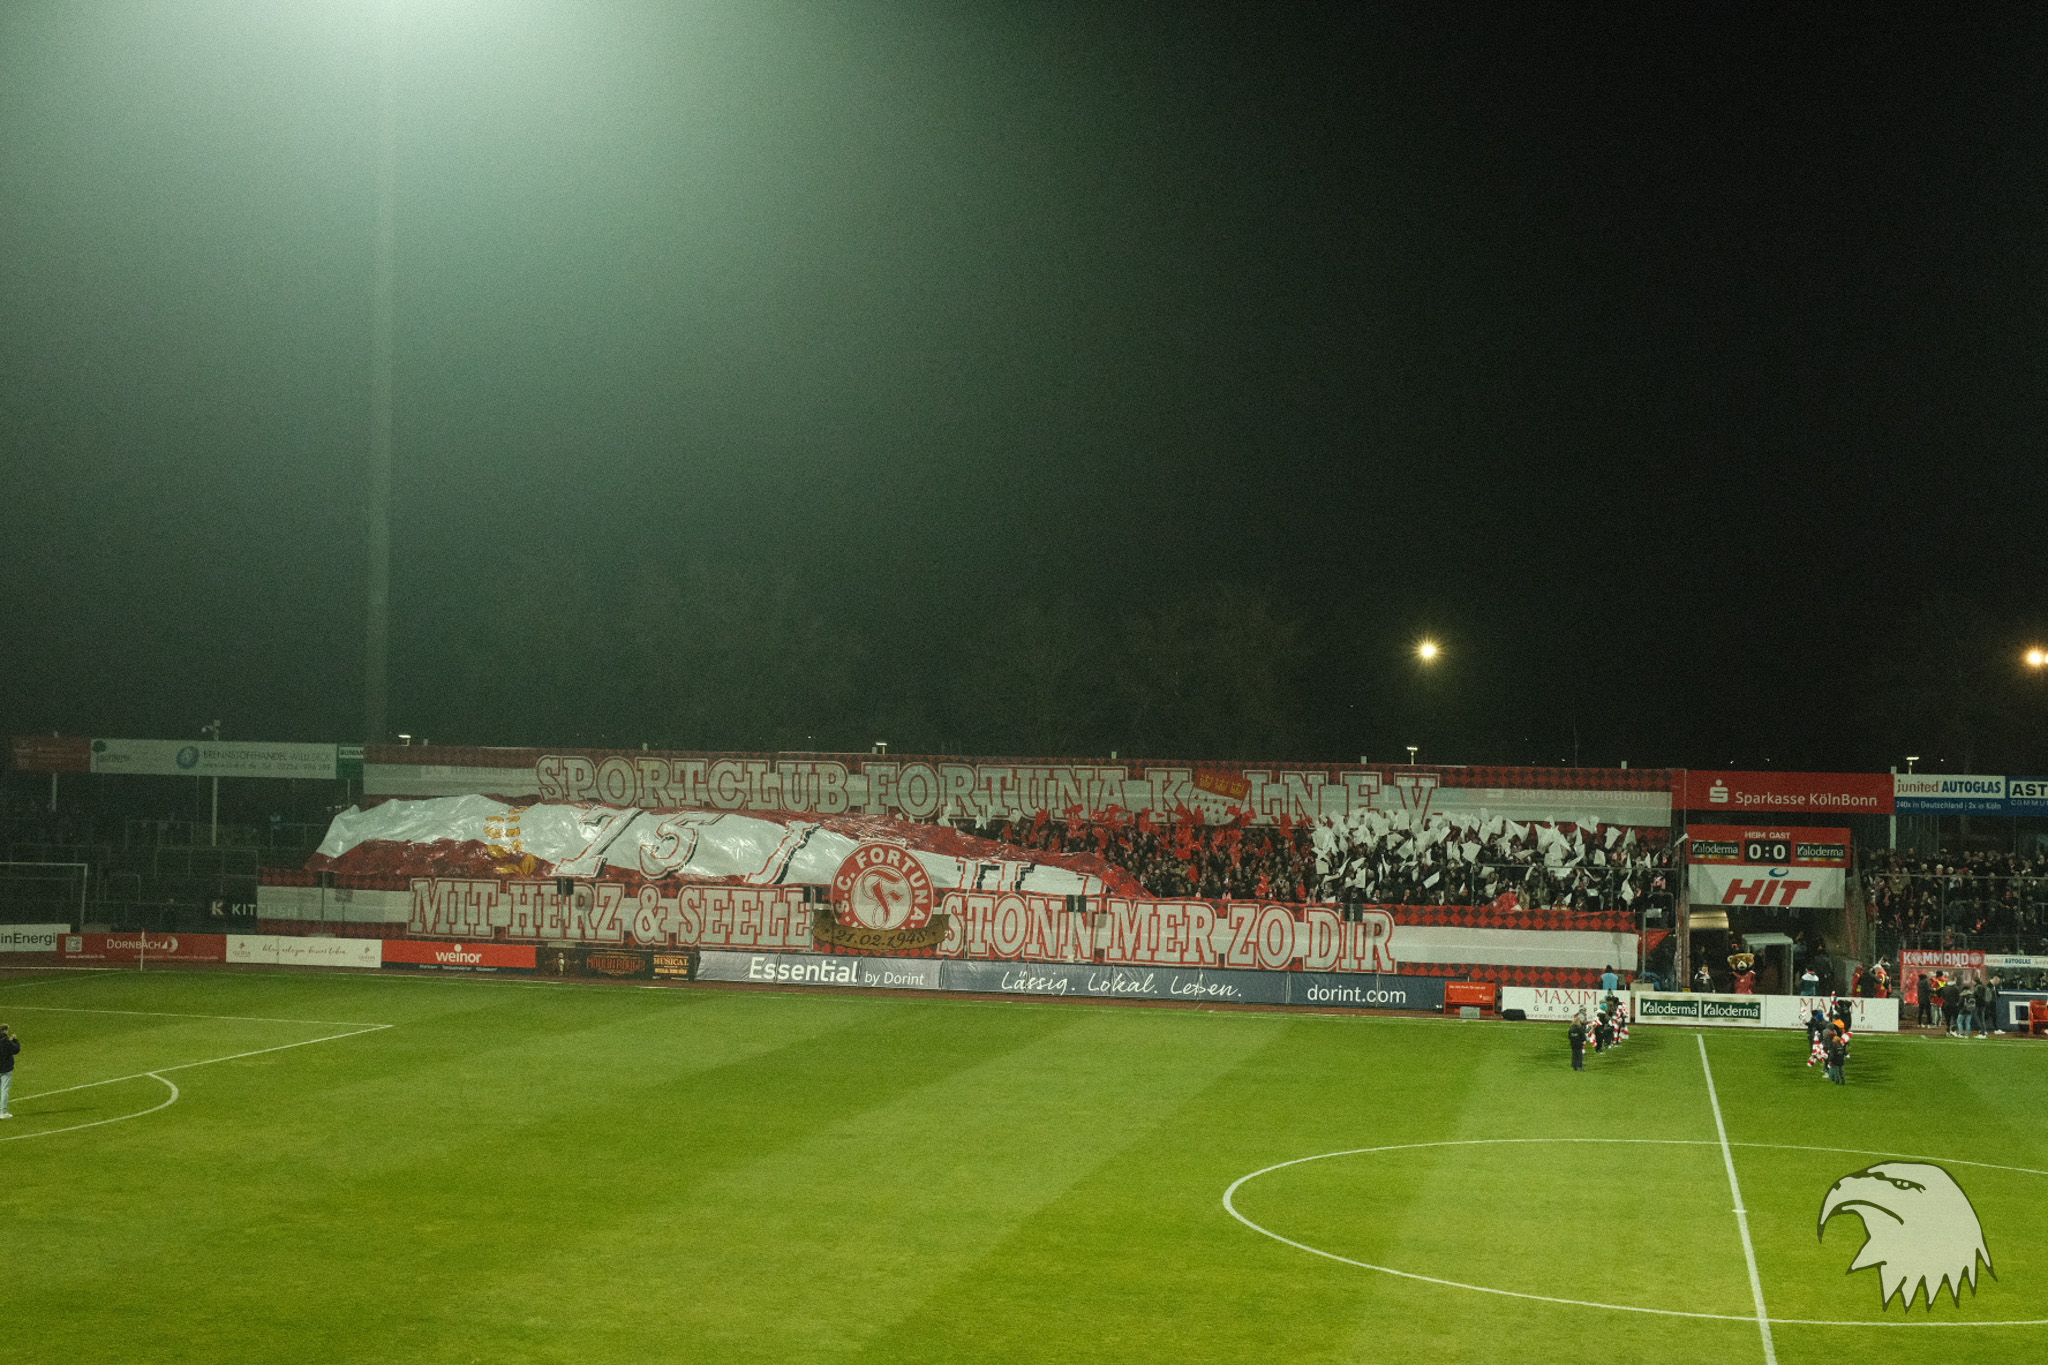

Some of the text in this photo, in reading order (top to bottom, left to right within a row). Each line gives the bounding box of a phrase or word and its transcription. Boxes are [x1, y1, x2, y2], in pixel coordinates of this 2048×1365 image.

[536, 755, 849, 813] SPORTCLUB
[862, 762, 1133, 823] FORTUNA
[1145, 767, 1328, 829] KLN
[1896, 779, 2001, 794] junited AUTOGLAS
[1735, 791, 1878, 806] Sparkasse KölnBonn
[1692, 841, 1739, 854] Kaloderma
[1749, 844, 1786, 860] 0:0
[1797, 844, 1844, 857] Kaloderma
[855, 847, 930, 923] FORTUNA
[1722, 879, 1811, 905] HIT
[407, 878, 1398, 974] MIT HERZ & SEELE STONN MER ZO DIR
[106, 938, 161, 950] DORNBACH
[834, 927, 930, 949] 21.02.1948
[435, 944, 482, 963] weinor
[653, 957, 690, 966] MUSICAL
[749, 957, 925, 987] Essential by Dorint
[1001, 970, 1242, 998] Lässig. Lokal. Leben.
[1307, 983, 1406, 1004] dorint.com
[1534, 989, 1598, 1006] MAXIM
